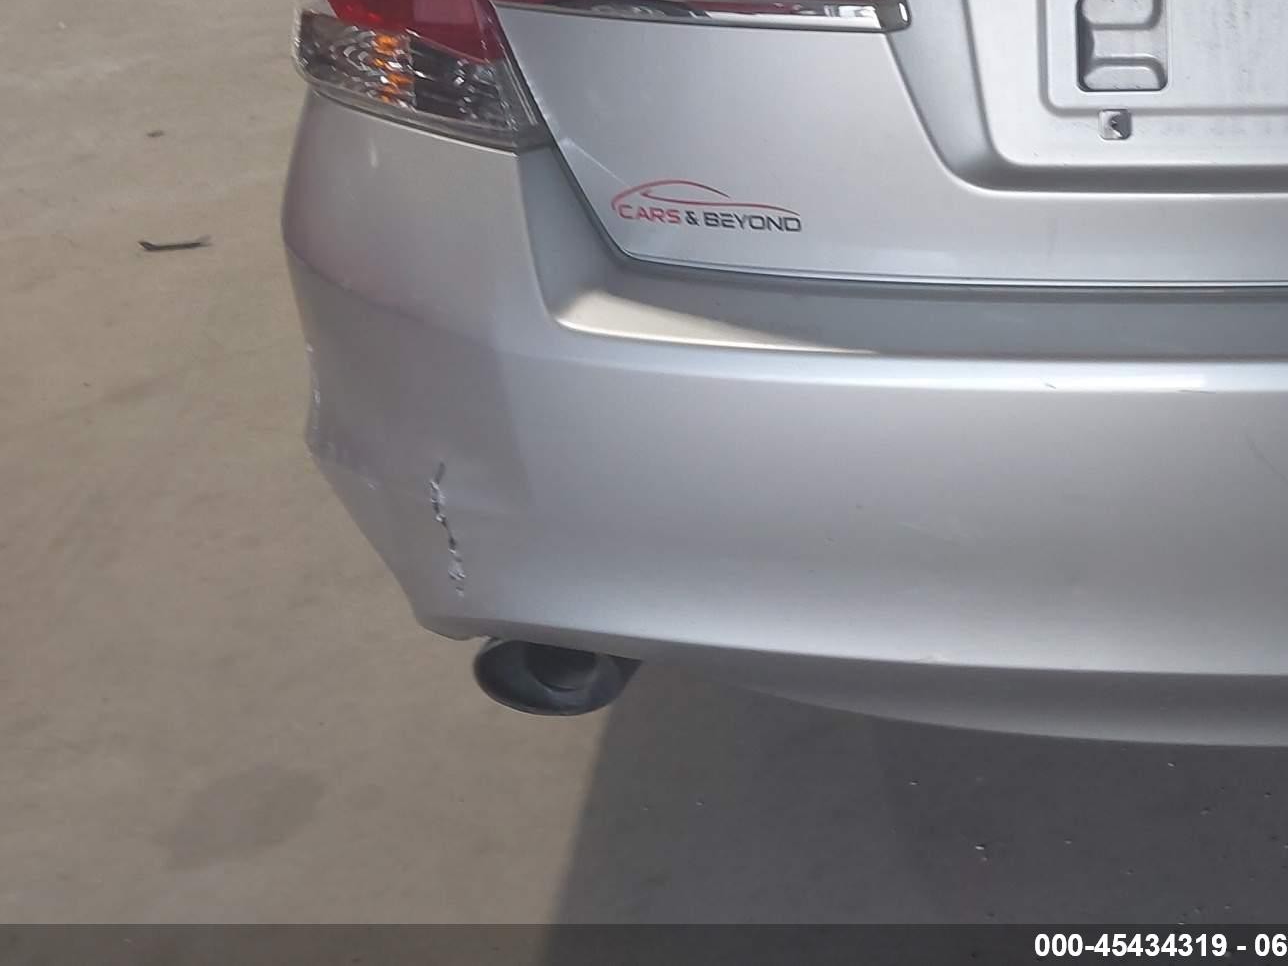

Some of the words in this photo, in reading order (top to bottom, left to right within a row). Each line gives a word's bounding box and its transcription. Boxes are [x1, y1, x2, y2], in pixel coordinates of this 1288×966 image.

[618, 203, 681, 223] CARS
[685, 210, 700, 226] &
[703, 211, 802, 232] BEYOND
